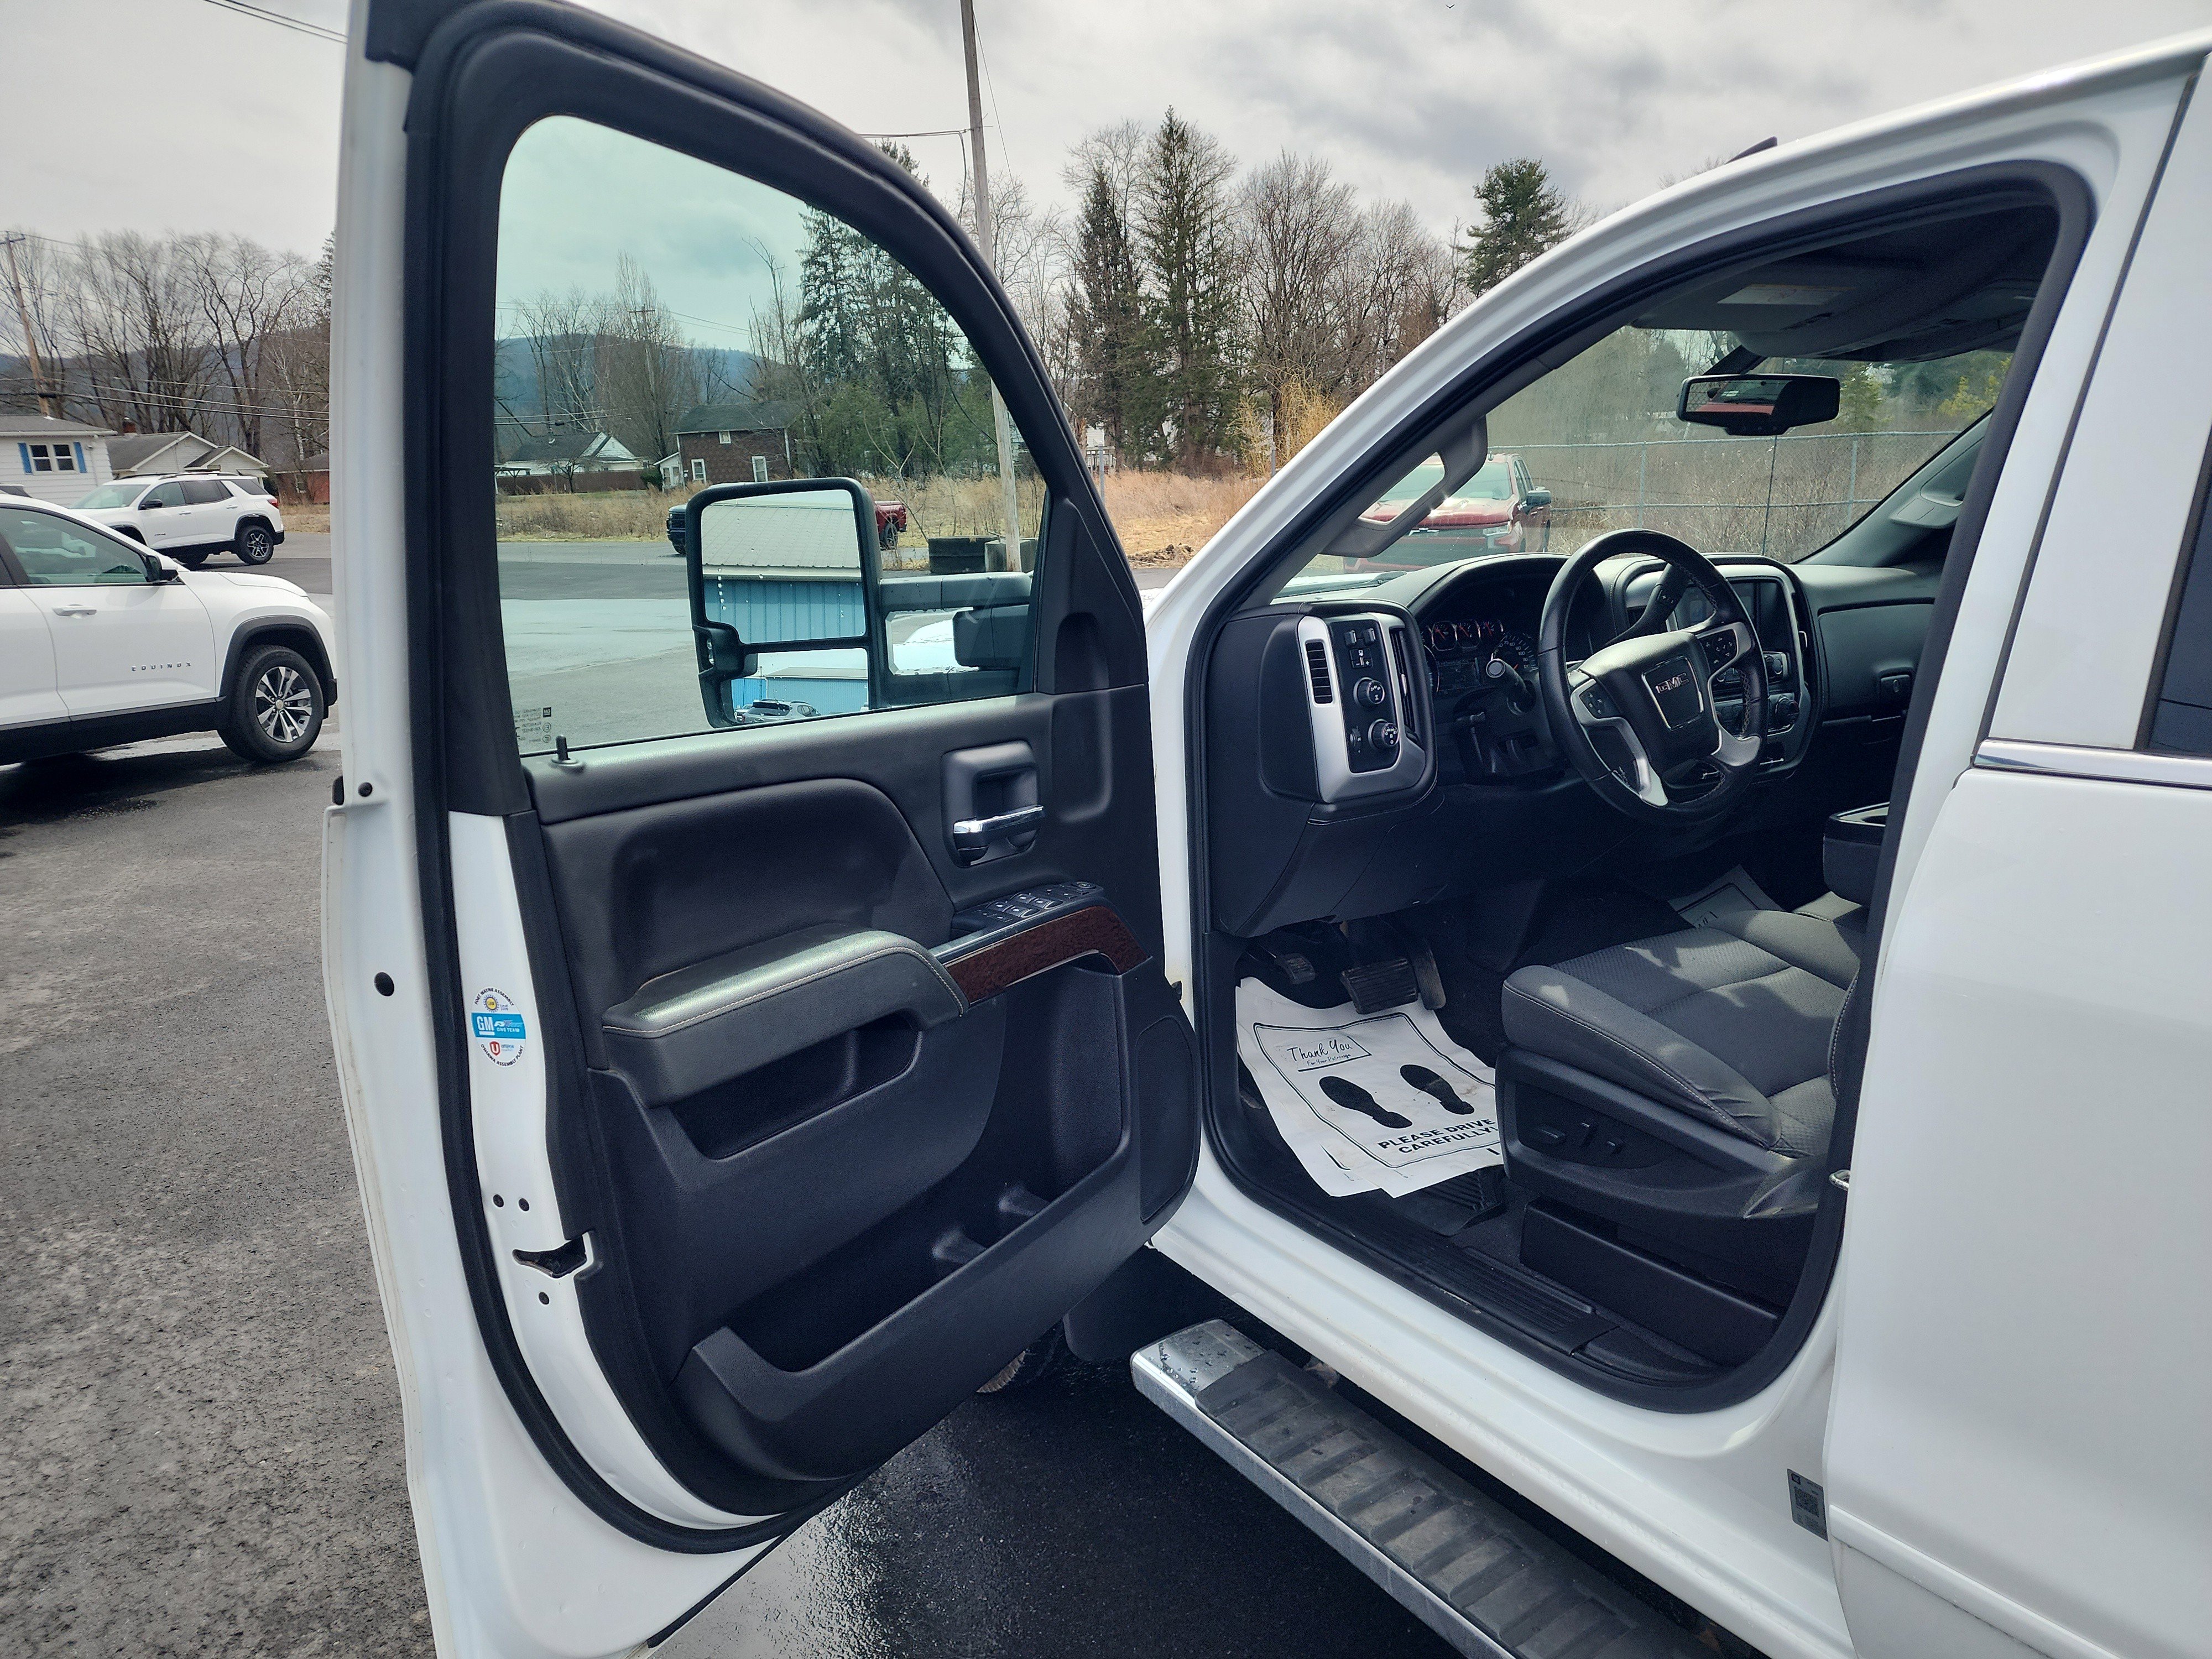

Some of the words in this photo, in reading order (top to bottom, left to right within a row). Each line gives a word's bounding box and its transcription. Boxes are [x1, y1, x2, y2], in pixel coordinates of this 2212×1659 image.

[1655, 672, 1689, 693] GMC
[494, 989, 515, 1006] ASSEMBLY
[476, 1016, 494, 1031] GM
[481, 1044, 496, 1063] OSHAWA
[496, 1058, 517, 1067] ASSEMBLY
[515, 1045, 524, 1060] PLANT
[1286, 1042, 1328, 1062] Thank
[1329, 1039, 1353, 1053] You
[1378, 1129, 1444, 1149] PLEASE
[1443, 1119, 1496, 1133] DRIVE
